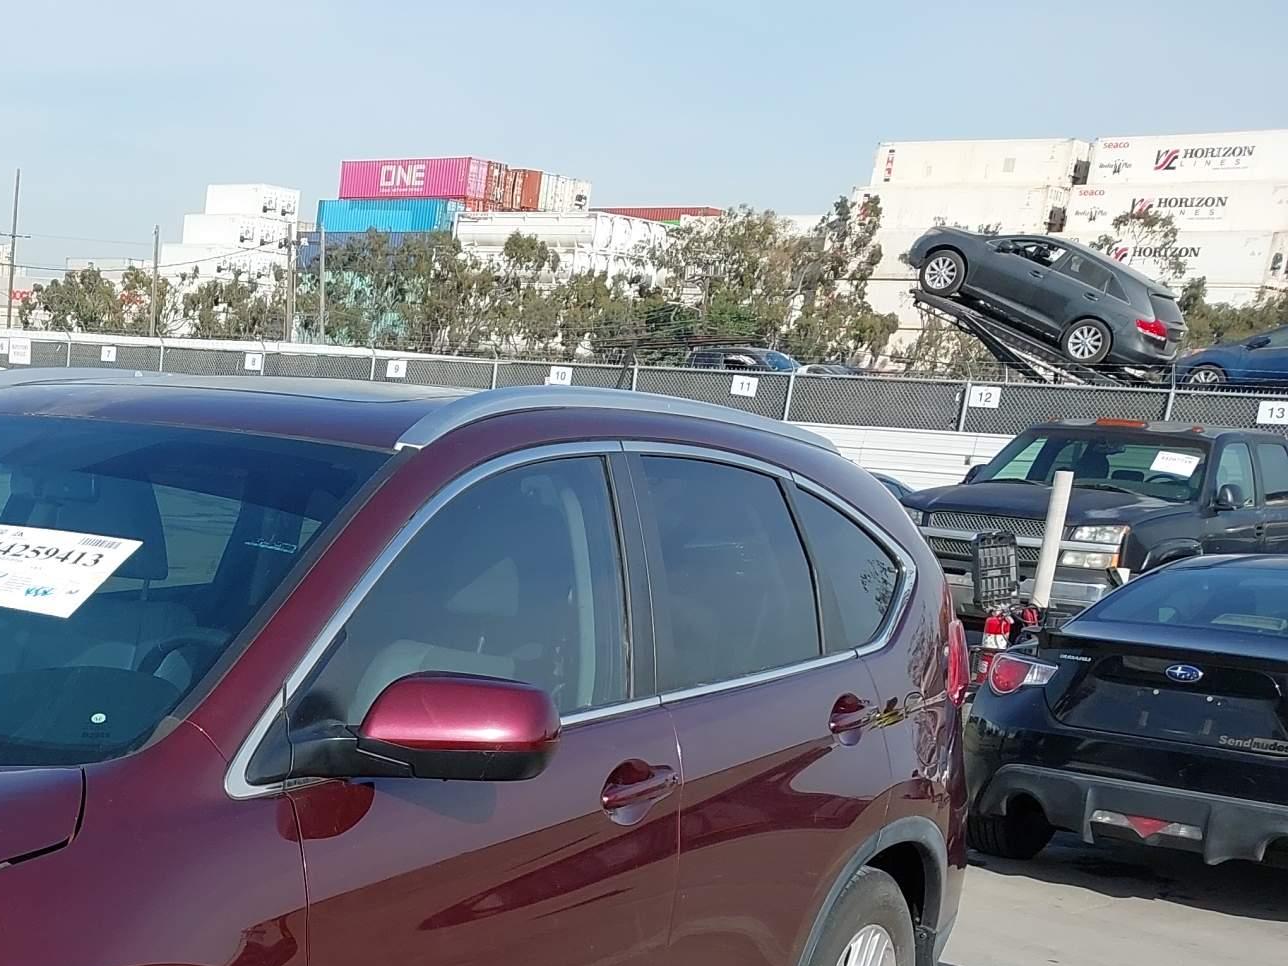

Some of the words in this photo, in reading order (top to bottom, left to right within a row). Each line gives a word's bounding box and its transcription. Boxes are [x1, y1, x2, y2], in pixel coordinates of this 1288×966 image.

[1103, 141, 1130, 149] seaco
[1182, 145, 1256, 159] HORIZON
[1179, 158, 1241, 167] LINES
[380, 164, 426, 186] ONE
[1157, 196, 1229, 208] HORIZON
[1167, 208, 1215, 216] INES
[1132, 246, 1201, 258] HORIZON
[394, 364, 400, 374] 9
[555, 371, 567, 382] 10
[739, 381, 751, 392] 11
[977, 391, 993, 403] 12
[1267, 407, 1286, 419] 13
[1218, 735, 1252, 748] Send
